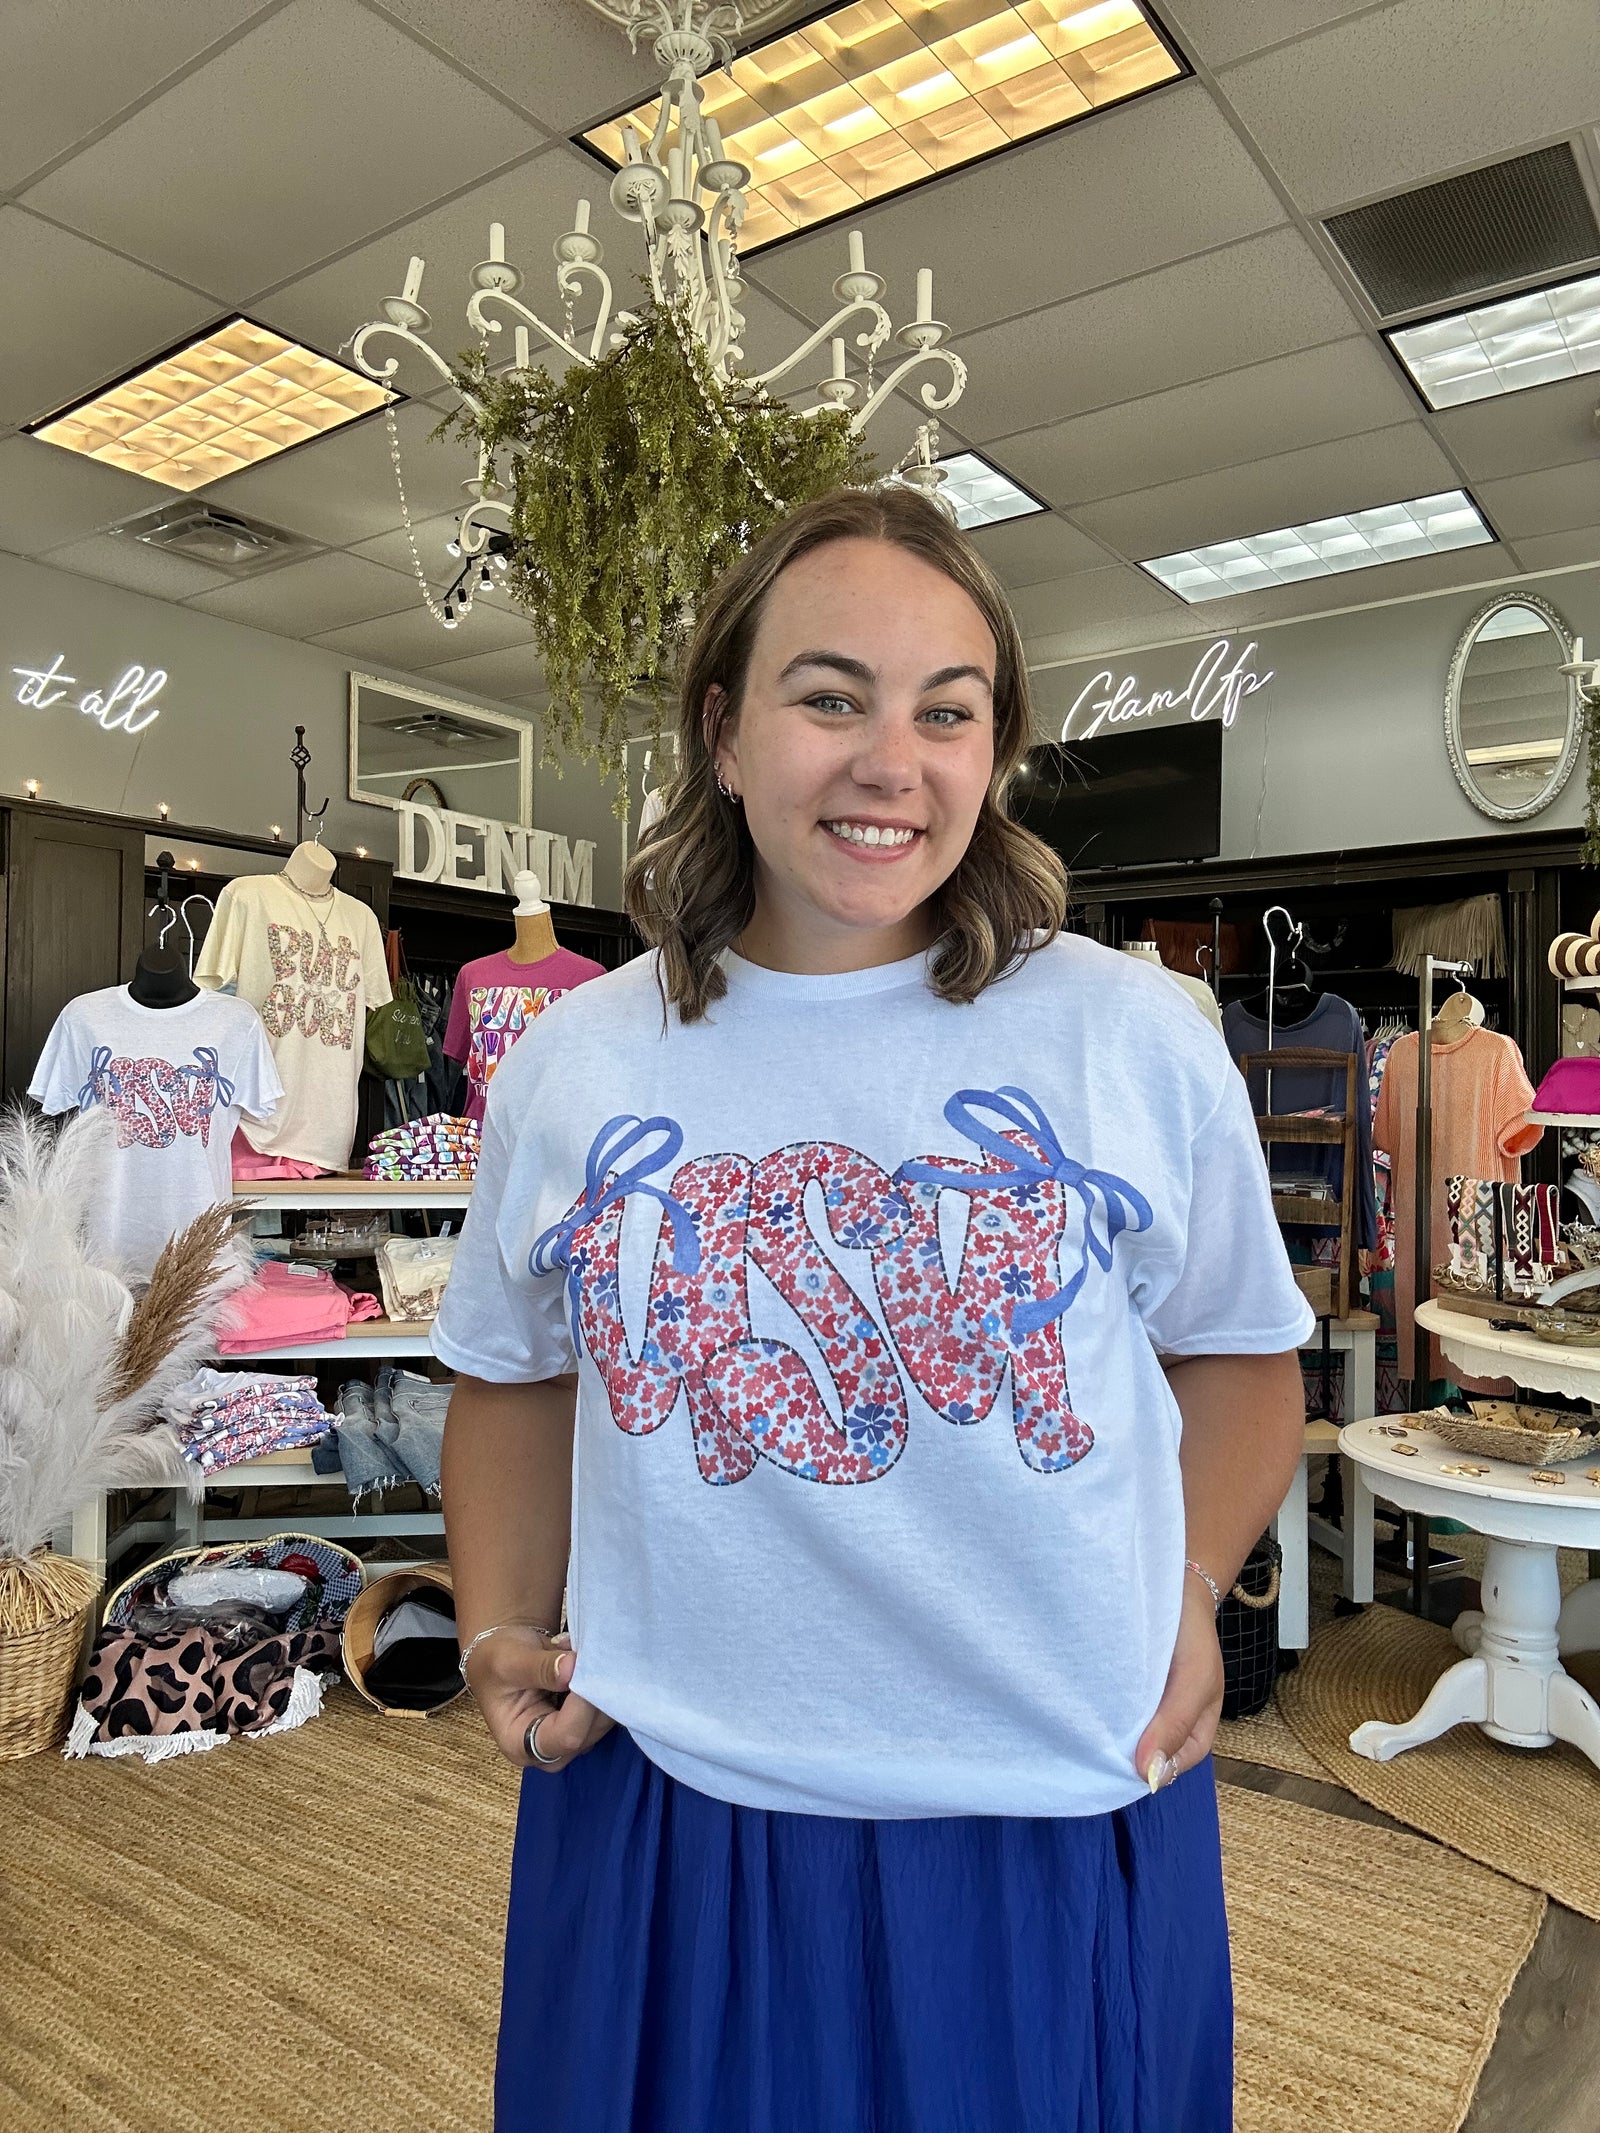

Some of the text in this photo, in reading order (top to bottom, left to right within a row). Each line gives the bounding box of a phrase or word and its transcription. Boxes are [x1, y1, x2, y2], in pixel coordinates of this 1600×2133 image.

[12, 654, 168, 734] it all
[1061, 639, 1275, 743] Glam Up
[393, 799, 597, 909] DENIM
[558, 1128, 1096, 1487] USA
